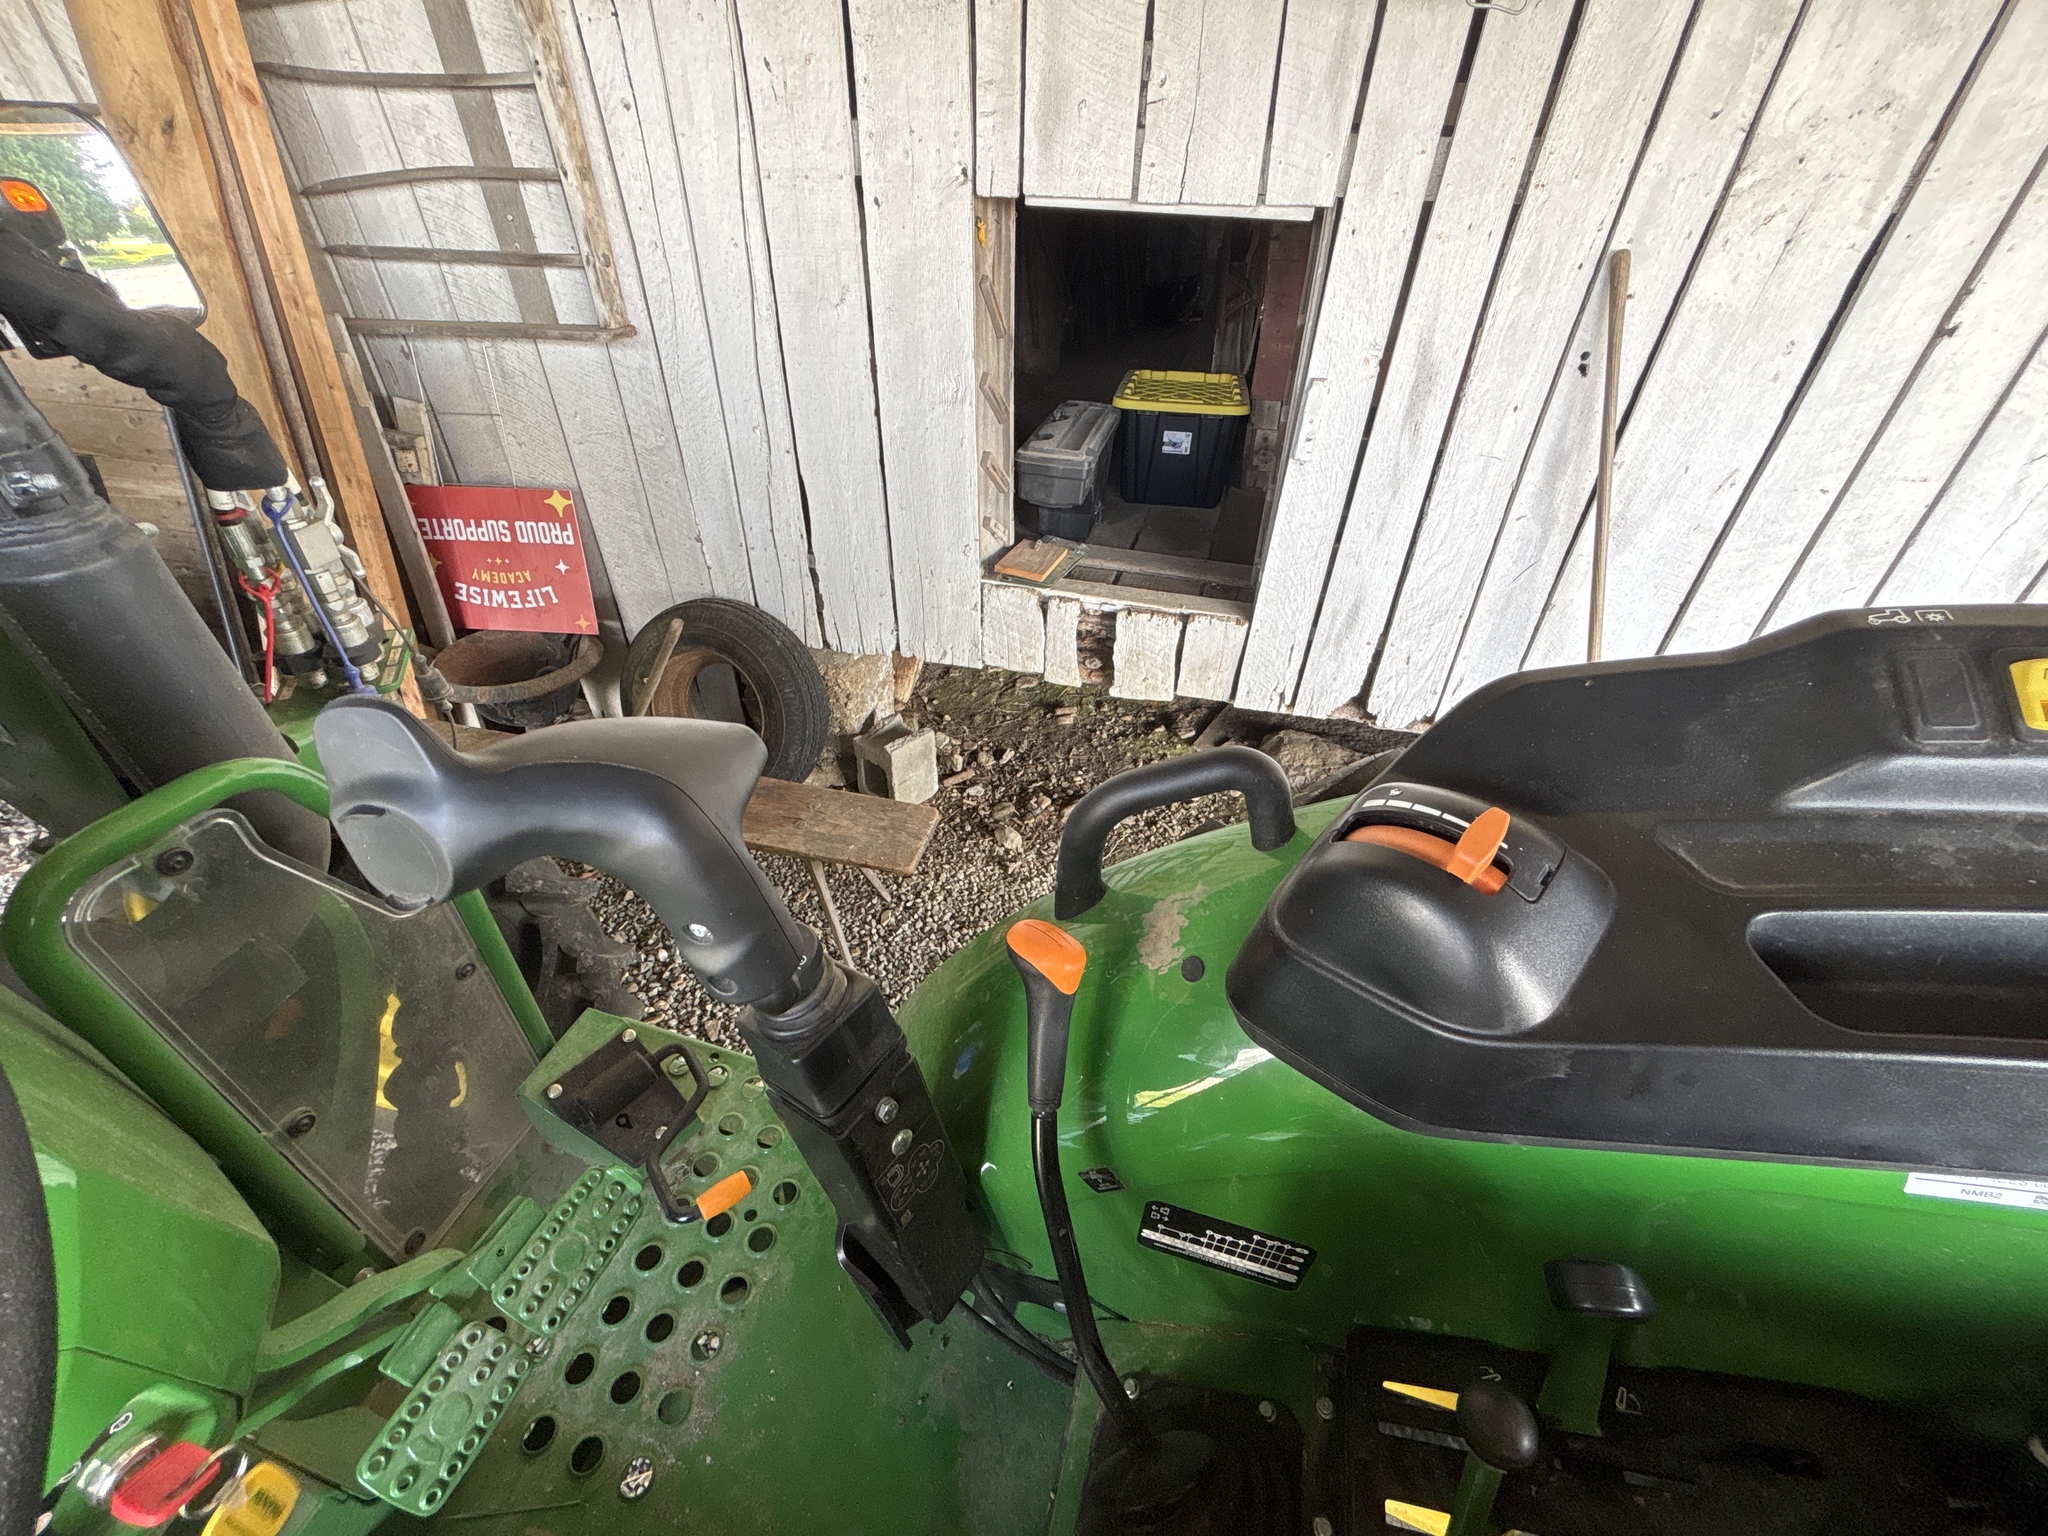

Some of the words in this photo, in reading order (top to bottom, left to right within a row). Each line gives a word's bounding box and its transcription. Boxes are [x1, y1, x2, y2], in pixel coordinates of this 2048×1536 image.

[418, 517, 512, 543] SUPPORTE
[515, 521, 575, 545] PROUD
[471, 567, 532, 585] ACADEMY
[455, 582, 559, 609] LIFEWISE
